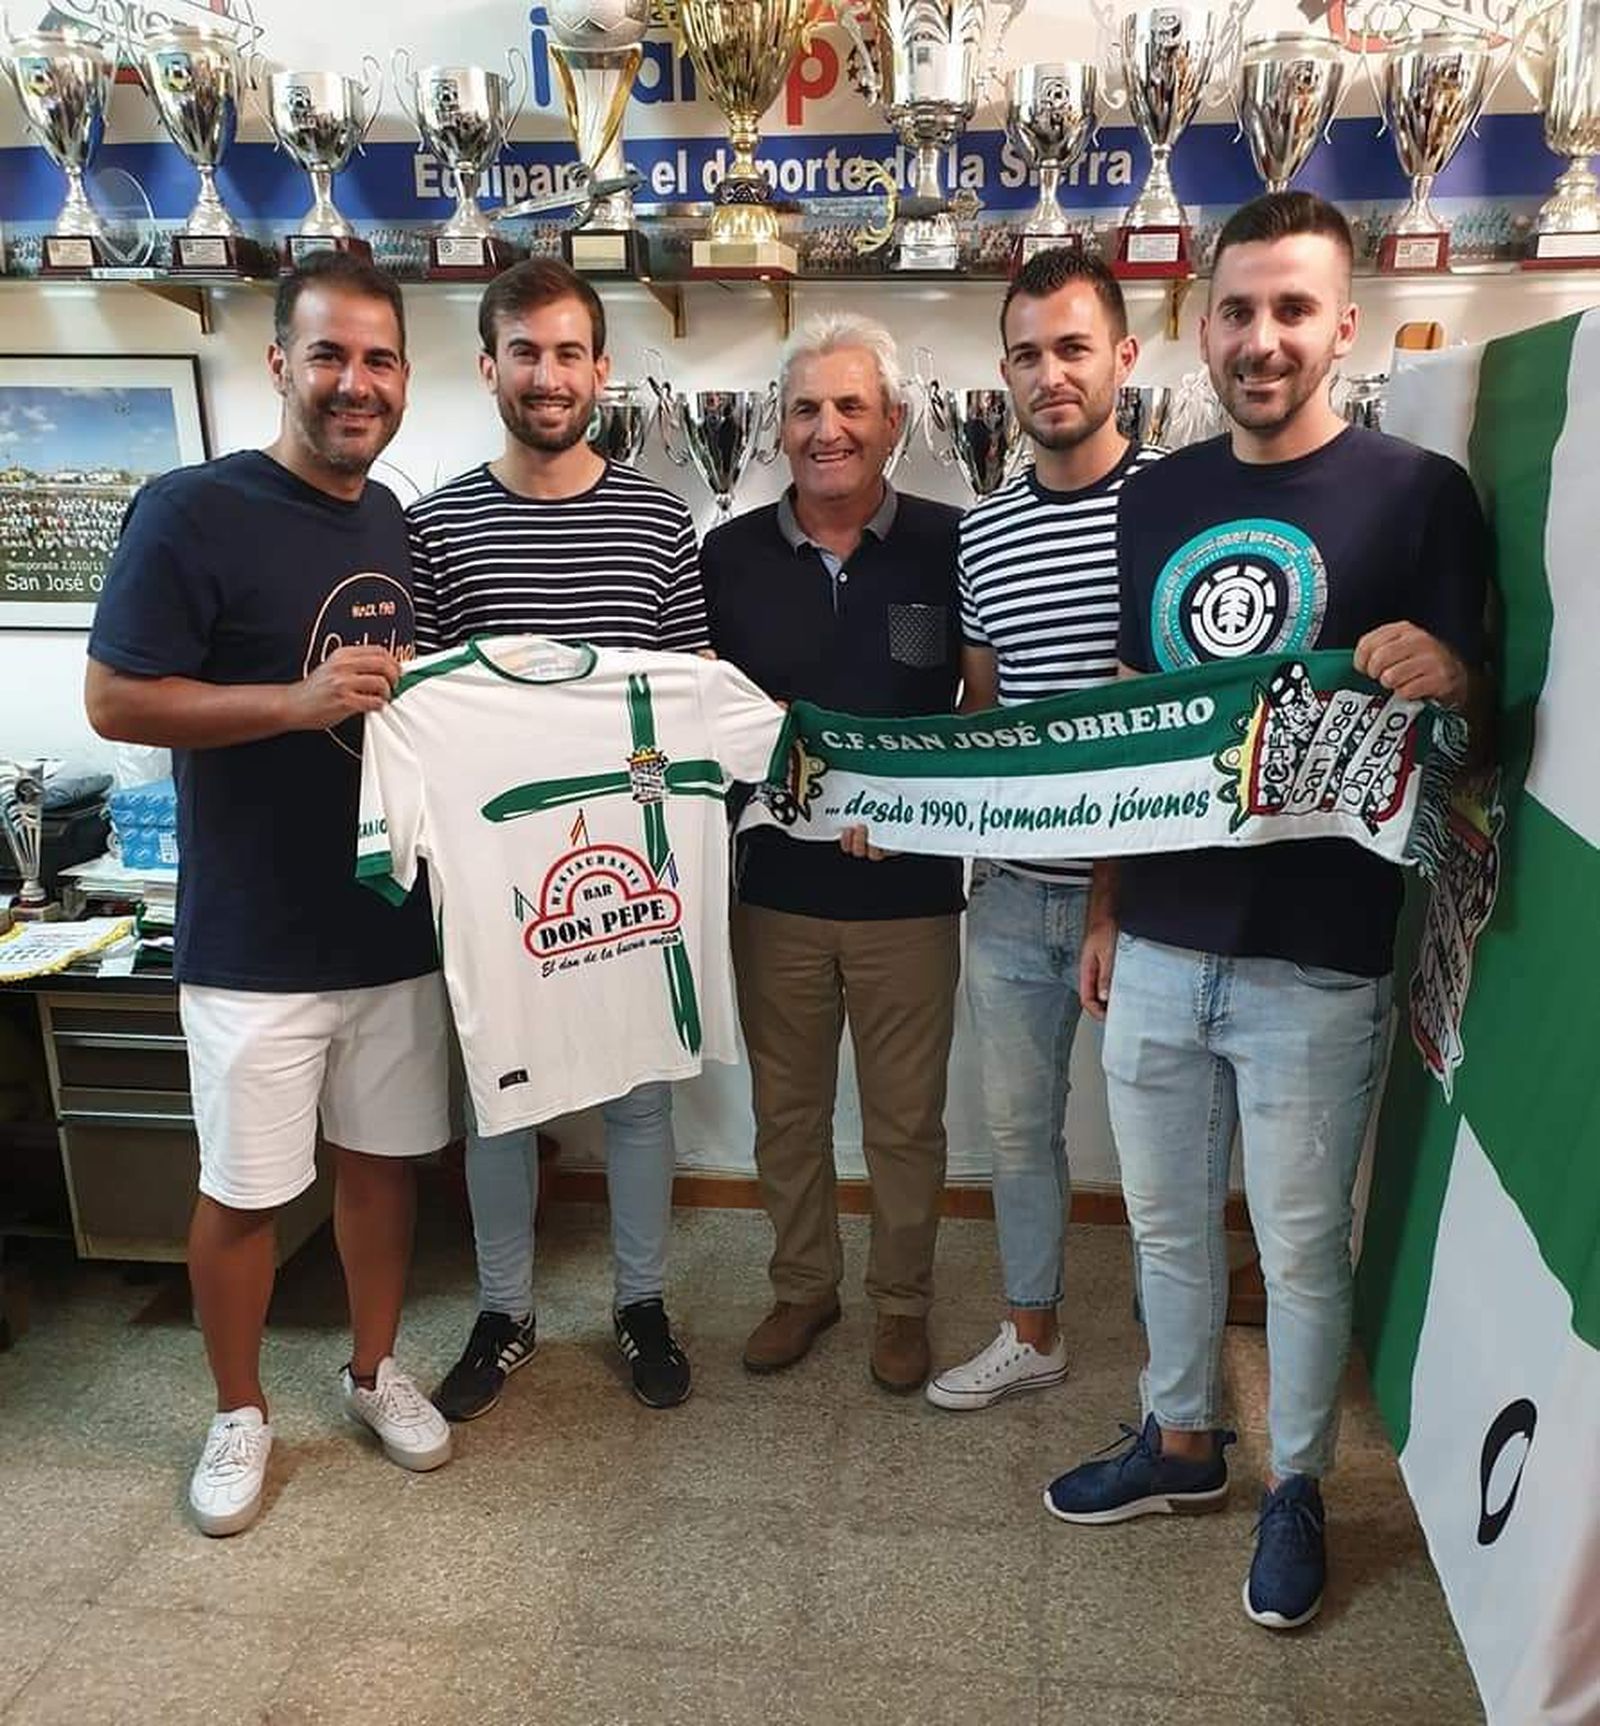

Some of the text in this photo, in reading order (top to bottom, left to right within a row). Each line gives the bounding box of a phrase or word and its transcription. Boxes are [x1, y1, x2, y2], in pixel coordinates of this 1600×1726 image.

[652, 150, 688, 194] el
[702, 149, 867, 193] dporte
[948, 144, 984, 188] la
[5, 572, 107, 592] San José O
[877, 733, 946, 750] SAN
[954, 721, 1041, 749] JOSÉ
[1047, 696, 1215, 744] OBRERO
[1292, 757, 1332, 804] San
[980, 794, 1101, 836] formando
[1109, 787, 1210, 828] jóvenes
[583, 884, 613, 901] BAR
[540, 899, 666, 950] DON PEPE
[583, 950, 597, 962] de
[601, 947, 613, 960] la
